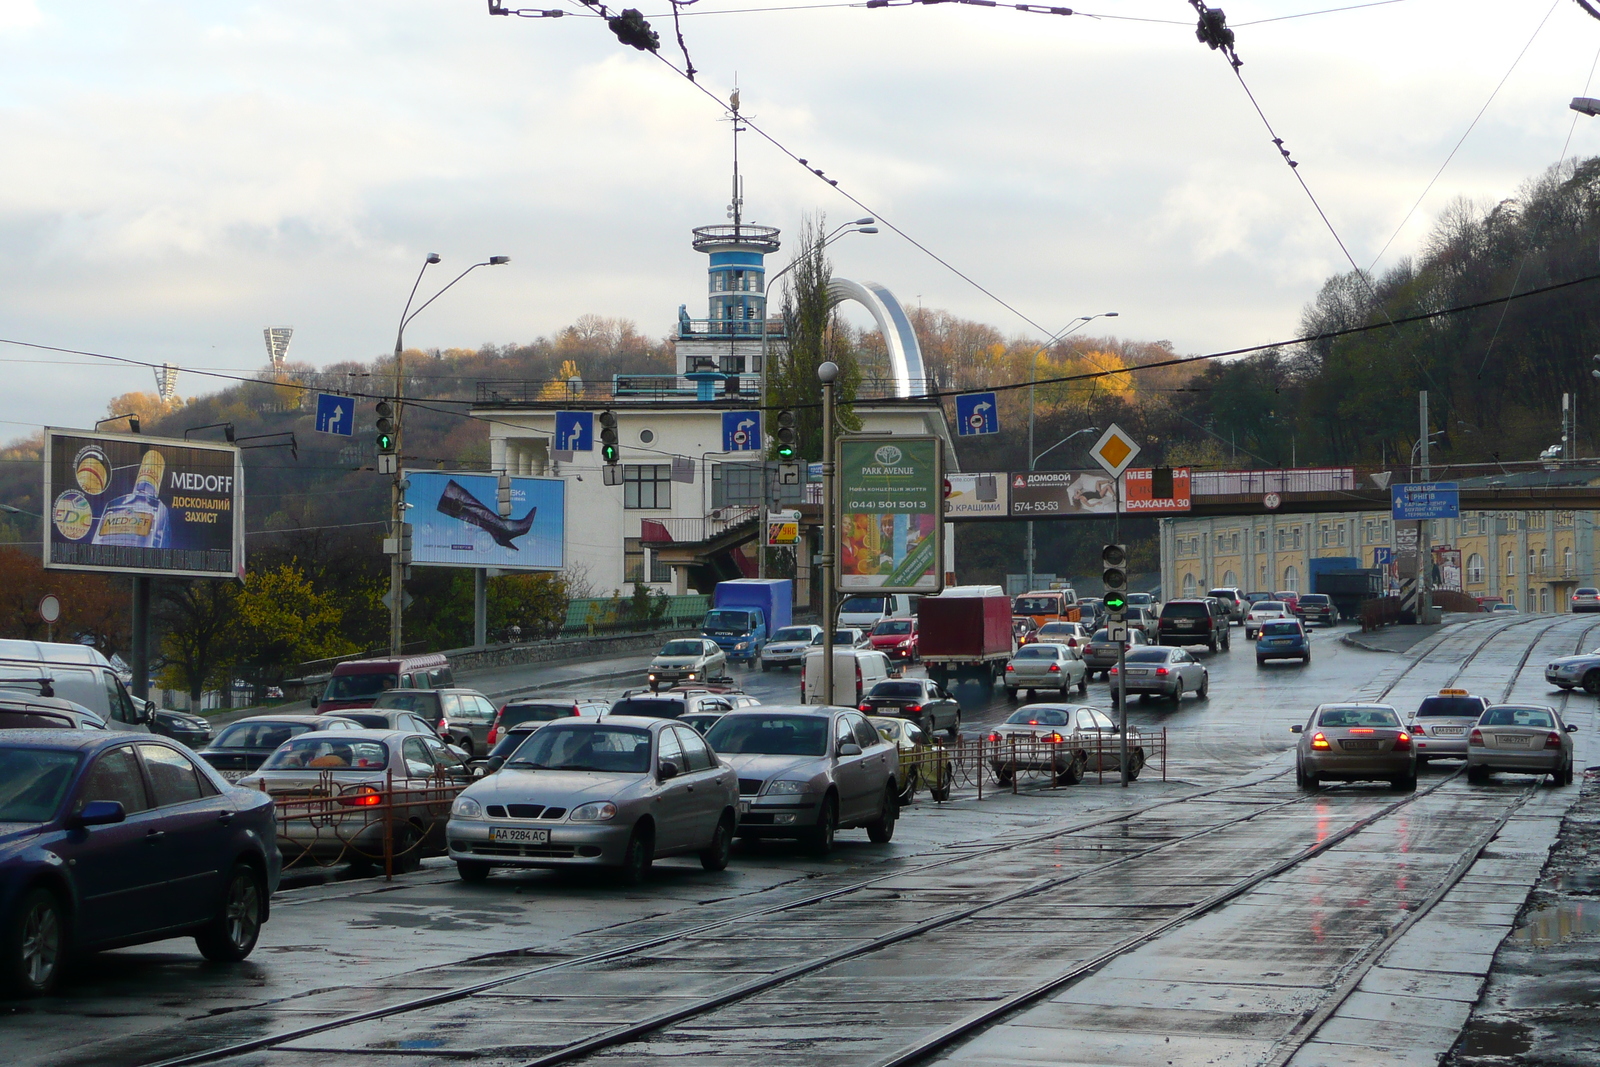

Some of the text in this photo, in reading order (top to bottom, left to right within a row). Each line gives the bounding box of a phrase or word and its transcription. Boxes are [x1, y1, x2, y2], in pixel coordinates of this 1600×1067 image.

[862, 467, 914, 475] PARK AVENUE
[1127, 470, 1188, 480] МЕБВА
[170, 471, 233, 493] MEDOFF
[1027, 472, 1071, 483] ДОМОВОЙ
[171, 496, 230, 510] ДОСКОНАЛИЙ
[956, 503, 1000, 512] КРАЩИМИ
[1034, 501, 1059, 511] 53-53
[1127, 499, 1189, 509] БАЖАНА 30
[105, 516, 150, 527] MEDOFF
[185, 511, 218, 523] ЗАХИСТ
[496, 830, 546, 841] AA 9284 AC
